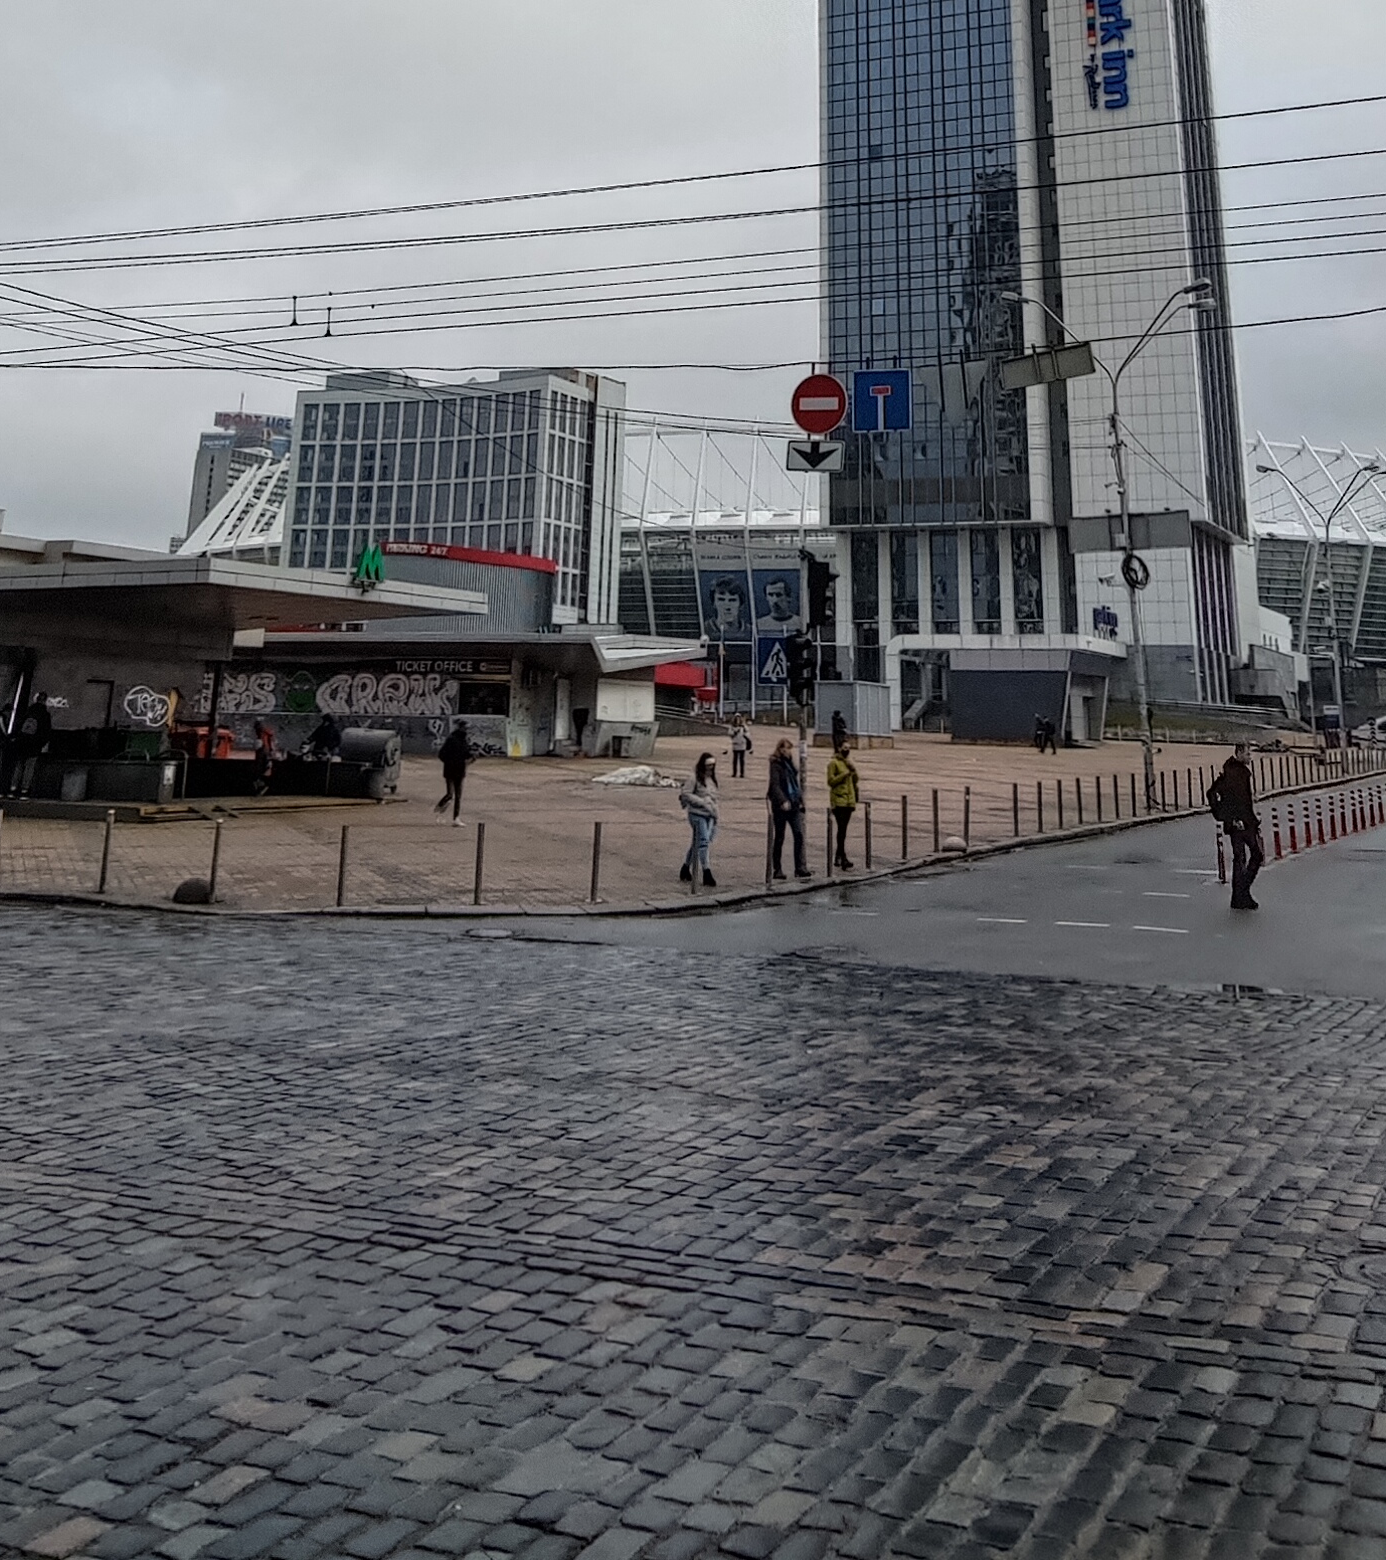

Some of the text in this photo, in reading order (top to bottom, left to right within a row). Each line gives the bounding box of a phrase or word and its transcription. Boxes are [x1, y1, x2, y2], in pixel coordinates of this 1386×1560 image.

[1101, 49, 1134, 110] inn
[395, 660, 433, 672] TICKET
[434, 660, 473, 672] OFFICE
